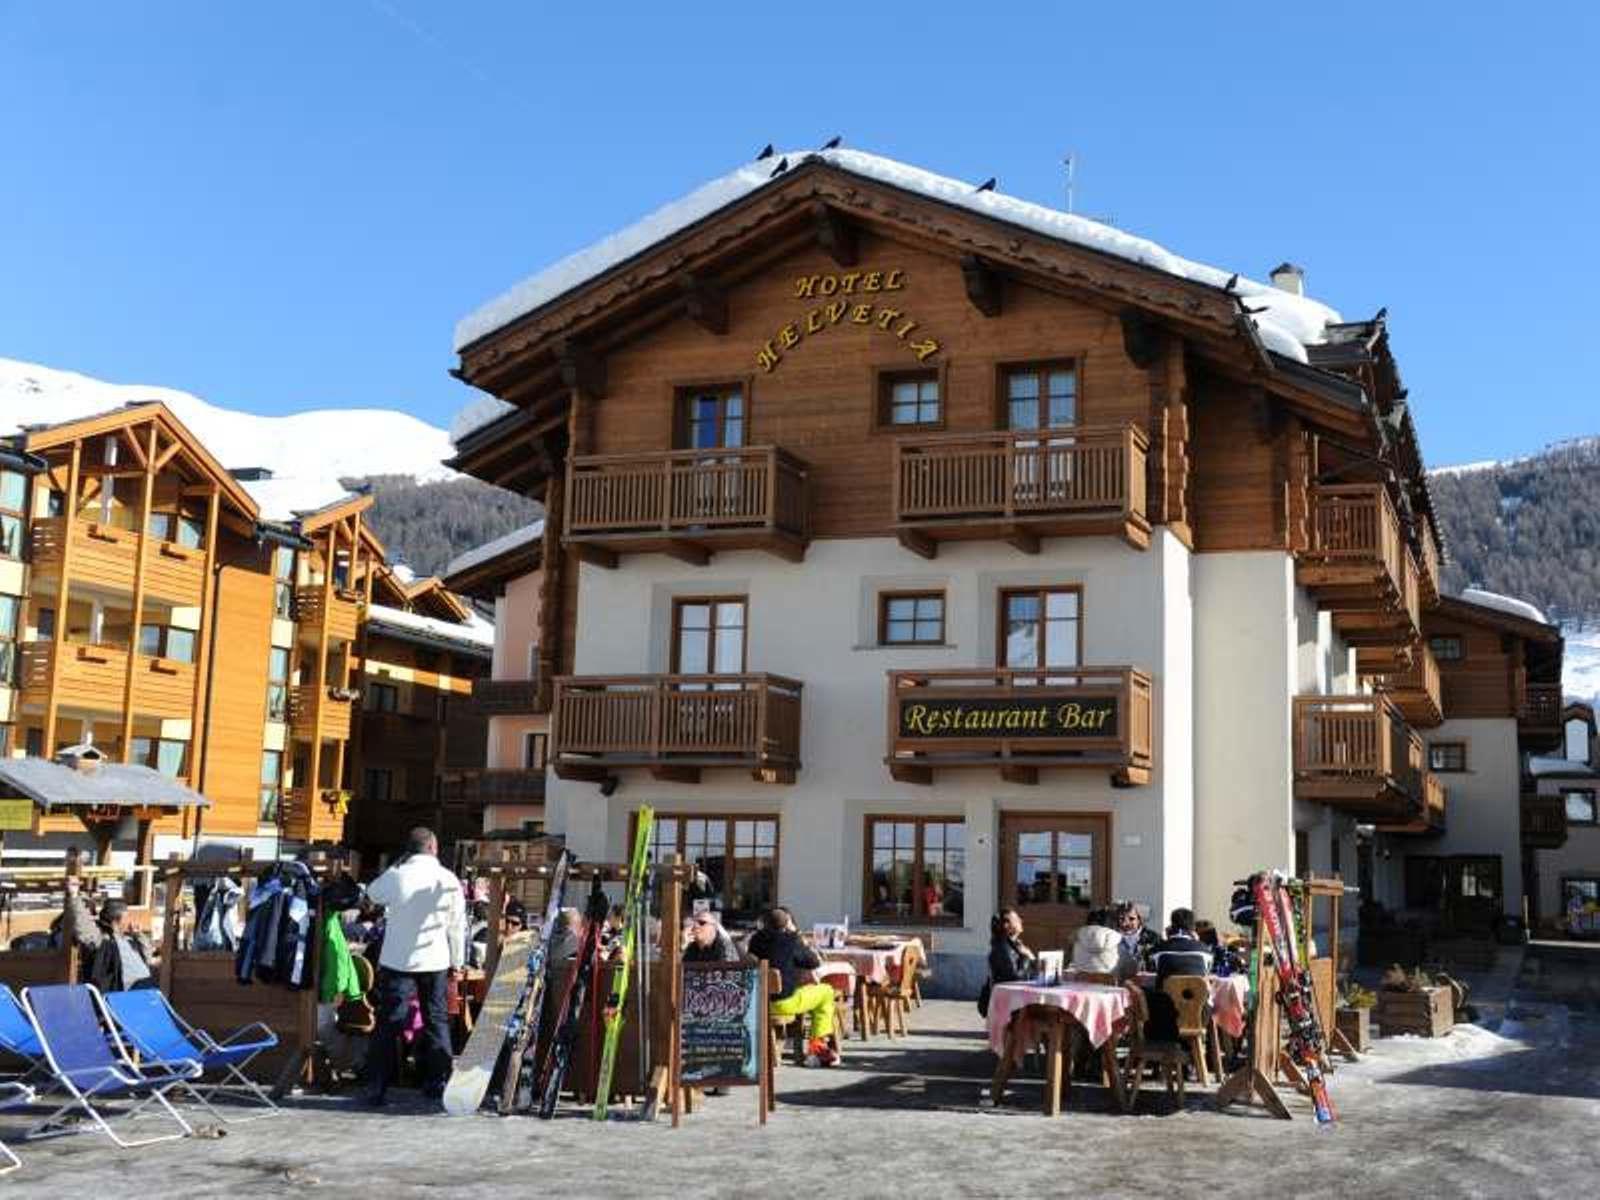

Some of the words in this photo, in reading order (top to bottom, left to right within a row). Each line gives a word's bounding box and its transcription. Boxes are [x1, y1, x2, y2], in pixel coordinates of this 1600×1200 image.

[795, 270, 904, 297] HOTEL
[757, 301, 940, 372] HELVETIA
[905, 704, 1047, 734] Restaurant
[1057, 703, 1112, 728] Bar
